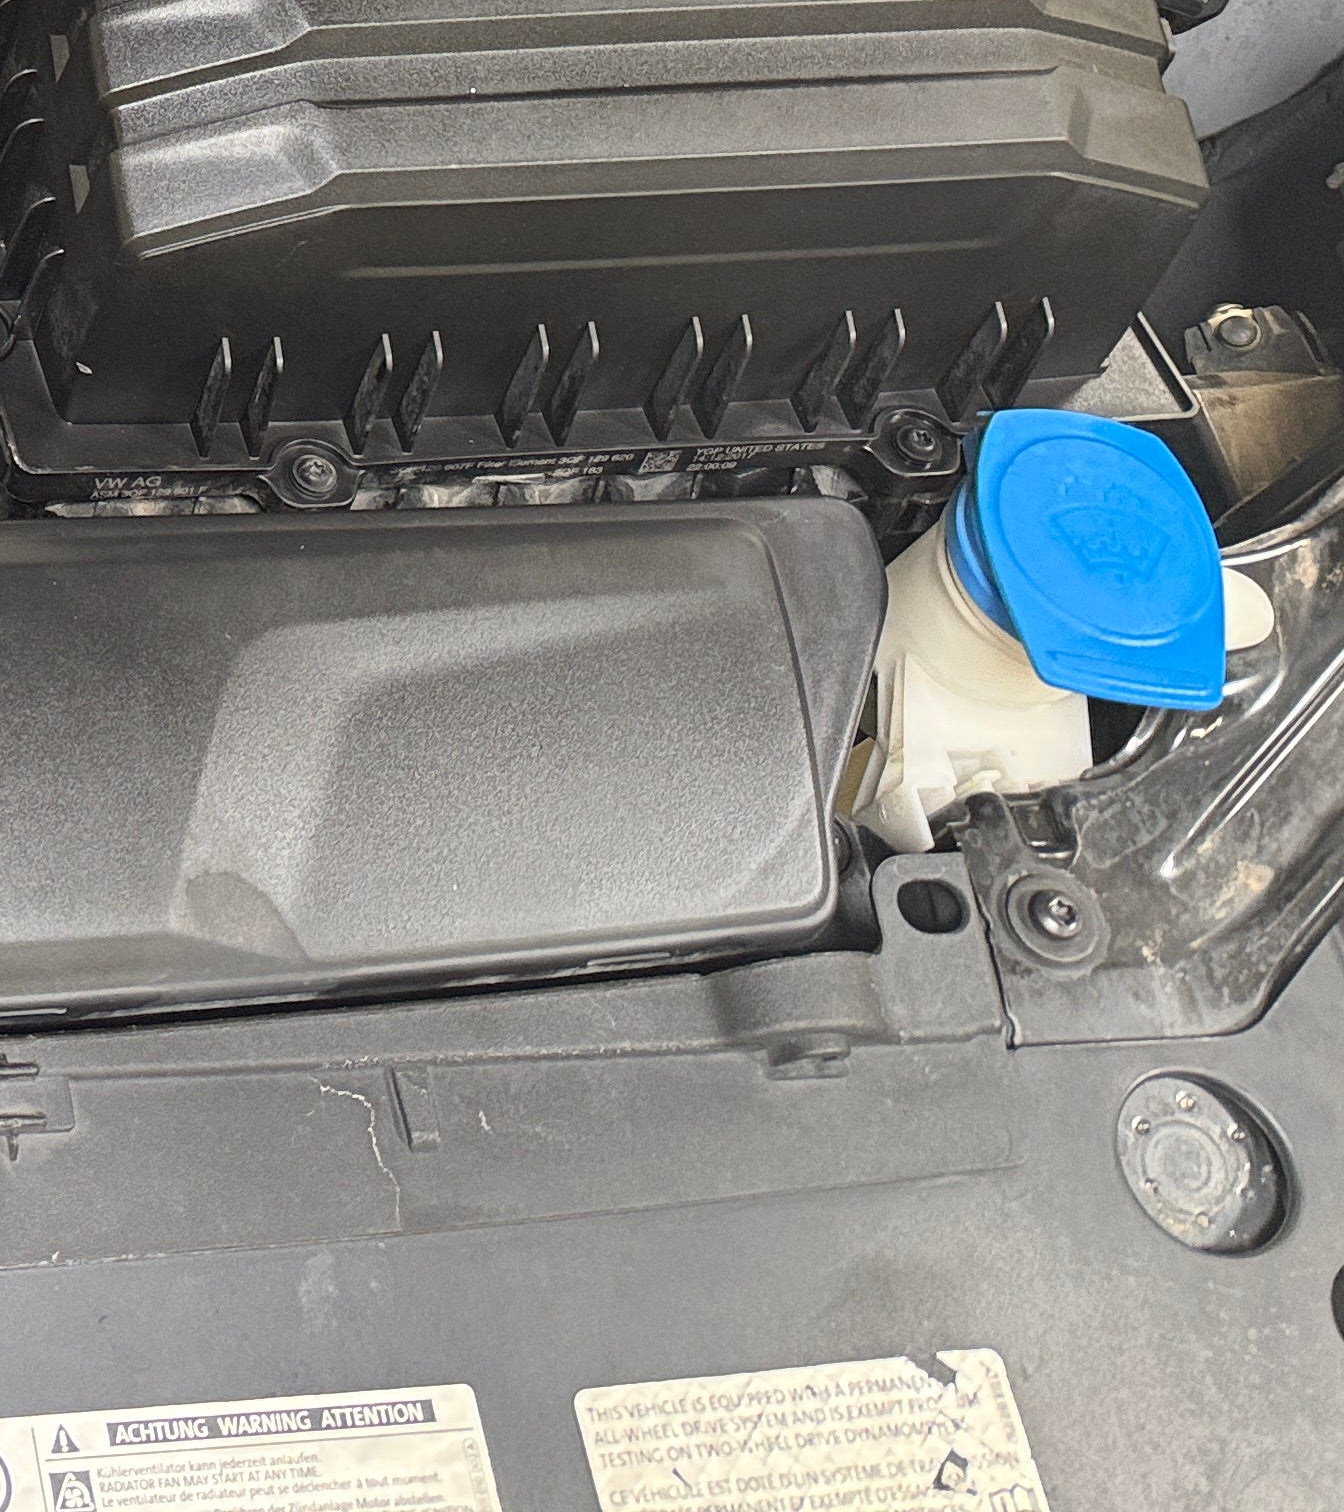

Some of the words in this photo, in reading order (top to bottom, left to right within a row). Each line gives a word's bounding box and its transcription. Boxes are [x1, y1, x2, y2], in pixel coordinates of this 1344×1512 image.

[725, 444, 772, 455] UNITED
[774, 441, 826, 452] STATES
[95, 477, 129, 490] VW
[131, 475, 162, 488] AG
[586, 1404, 623, 1423] THIS
[623, 1398, 688, 1419] VEHICLE
[691, 1395, 707, 1413] IS
[709, 1388, 787, 1411] EQUPPED
[848, 1375, 933, 1397] PERMANEN
[115, 1418, 209, 1444] ACHTUNG
[216, 1410, 311, 1437] WARNING
[321, 1402, 425, 1429] ATTENTION
[594, 1423, 680, 1445] ALL-WHEEL
[792, 1407, 826, 1425] AND
[846, 1398, 904, 1420] EXEMPT
[189, 1460, 217, 1473] kann
[598, 1447, 664, 1469] TESTING
[666, 1444, 692, 1463] ON
[99, 1478, 155, 1494] RADIATOR
[158, 1476, 181, 1489] FAN
[183, 1474, 209, 1487] MAY
[211, 1471, 245, 1486] START
[247, 1470, 261, 1482] AT
[264, 1467, 287, 1480] ANY
[707, 1478, 732, 1495] EST
[101, 1497, 115, 1508] Le
[116, 1492, 178, 1507] ventilateur
[179, 1490, 193, 1503] de
[196, 1487, 247, 1501] radiateur
[249, 1484, 276, 1501] peut
